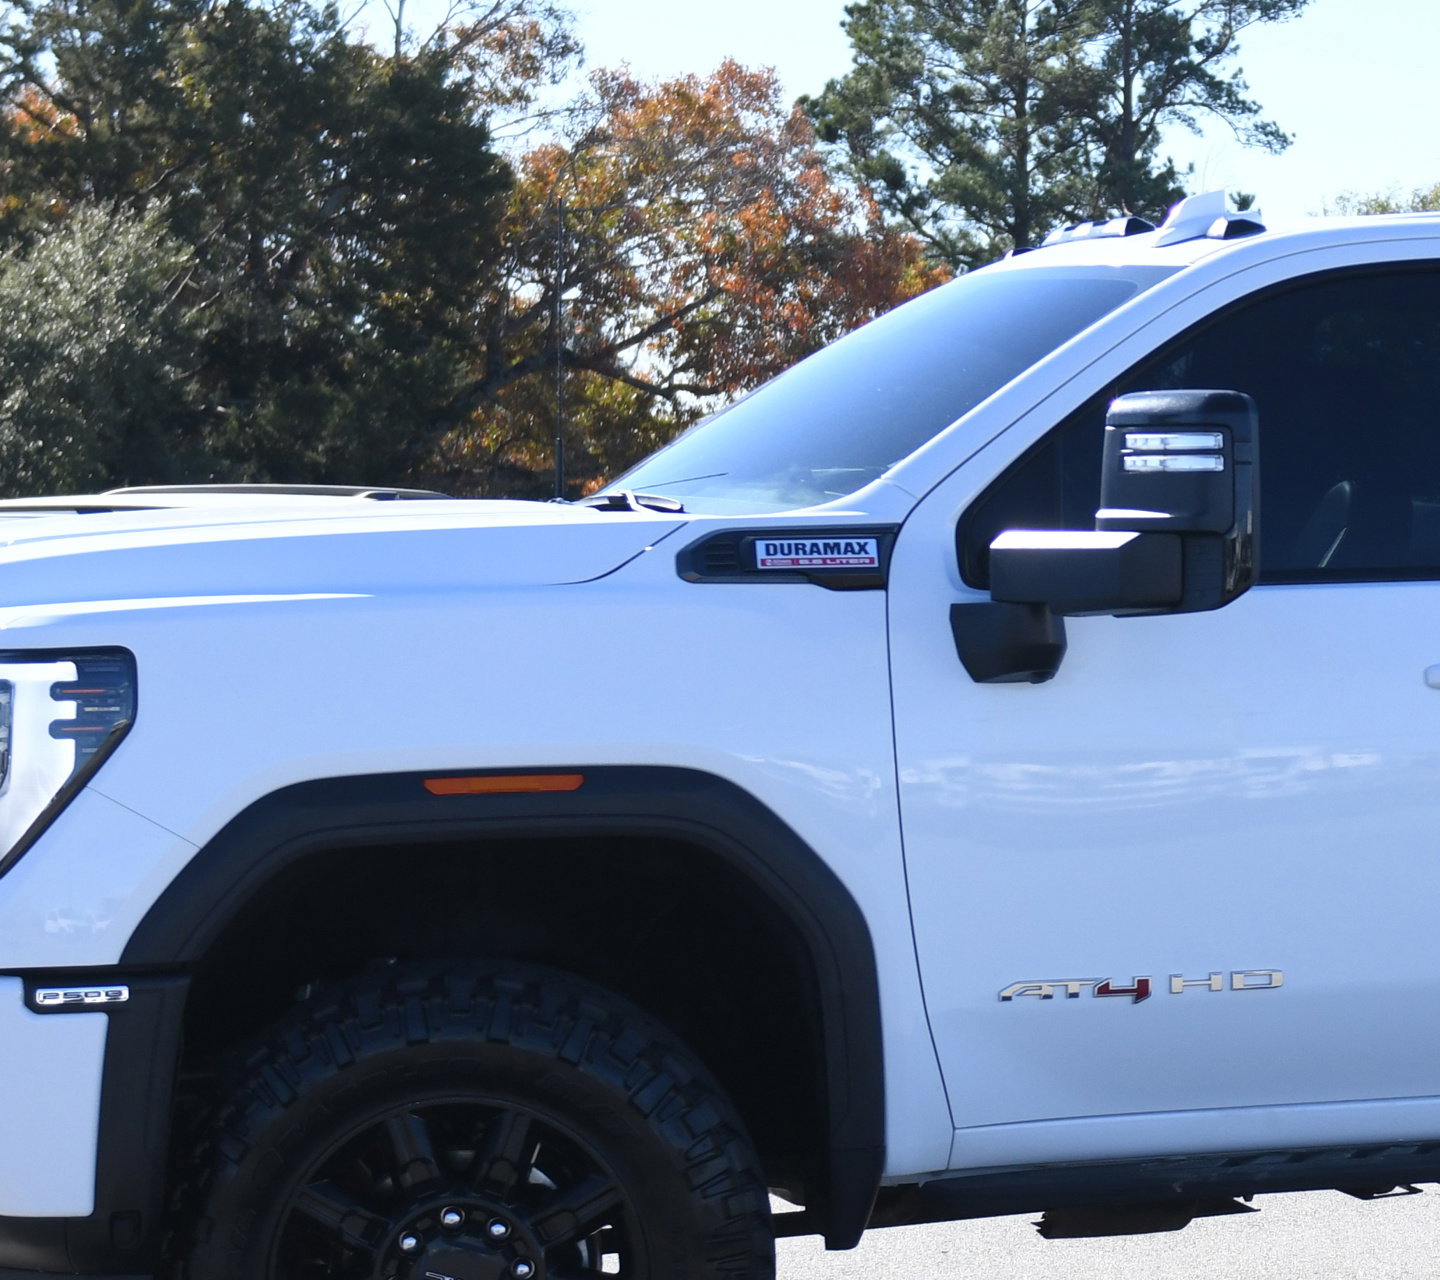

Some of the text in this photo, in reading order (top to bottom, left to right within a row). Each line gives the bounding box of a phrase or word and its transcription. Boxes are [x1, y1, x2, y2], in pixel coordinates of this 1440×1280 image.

[764, 541, 871, 556] DURAMAX
[997, 968, 1286, 1005] AT4 HD
